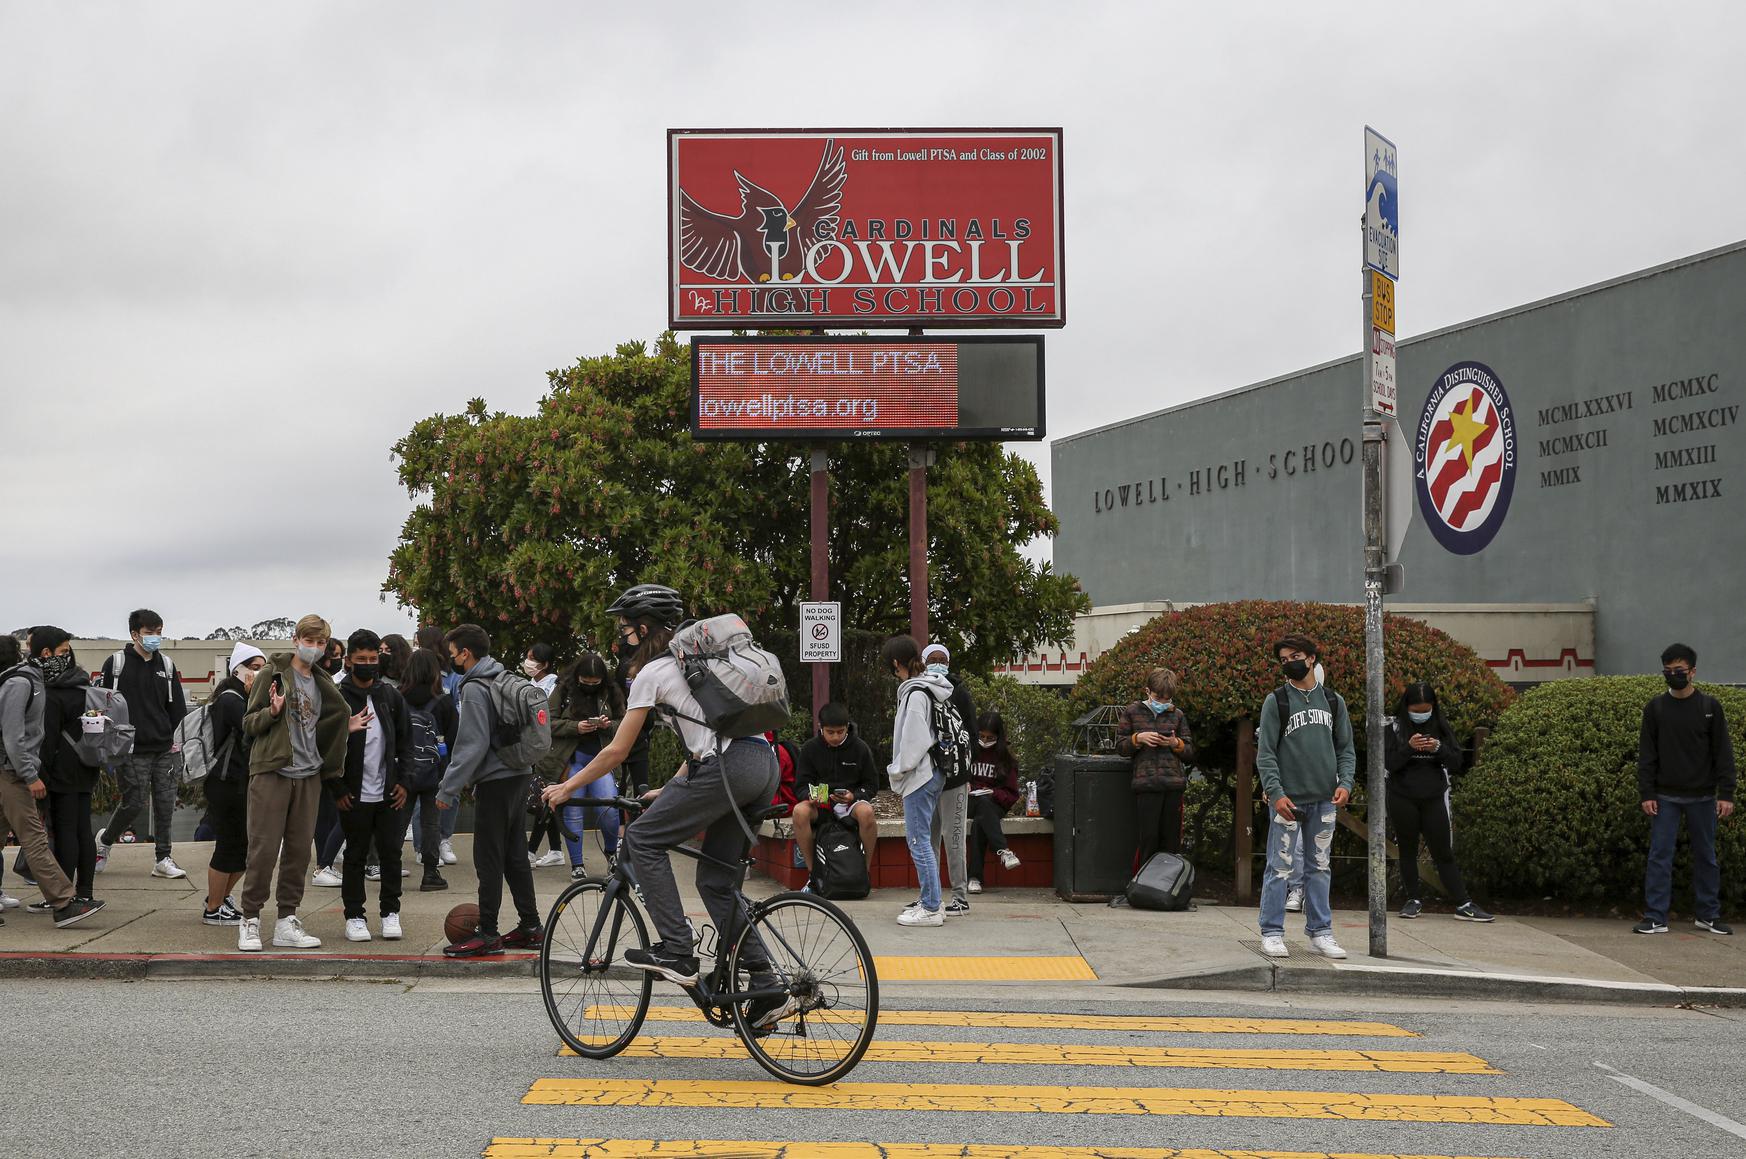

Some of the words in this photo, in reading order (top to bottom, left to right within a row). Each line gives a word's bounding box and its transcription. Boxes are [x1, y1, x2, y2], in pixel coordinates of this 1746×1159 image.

[851, 148, 868, 161] Gift
[872, 149, 894, 161] from
[897, 149, 927, 161] Lowell
[930, 149, 957, 160] PTSA
[959, 149, 977, 161] and
[979, 148, 1005, 160] Class
[1007, 148, 1018, 160] of
[1020, 148, 1046, 160] 2002
[813, 217, 1032, 241] CARDINALS
[764, 240, 1045, 285] LOWELL
[712, 288, 831, 314] HIGH
[853, 287, 1046, 314] SCHOOL
[1376, 277, 1391, 303] BUS
[1375, 301, 1393, 326] STOP
[699, 352, 745, 375] THE
[754, 352, 864, 375] LOWELL
[872, 351, 943, 374] PTSA
[1444, 367, 1504, 406] DISTINGUISHED
[1652, 373, 1720, 404] MCMXC
[1538, 391, 1633, 427] MCMLXXXVI
[1653, 405, 1740, 437] MCMXCIV
[1416, 387, 1444, 463] CALIFORNIA
[1500, 407, 1514, 470] SCHOOL
[1539, 429, 1608, 457] MCMXCII
[1654, 445, 1717, 470] MMXIII
[1094, 477, 1170, 514] LOWELL
[1189, 459, 1247, 496] HIGH
[1268, 438, 1354, 479] SCHOO
[1416, 468, 1425, 479] A
[1540, 466, 1581, 488] MMIX
[1656, 478, 1723, 505] MMXIX
[1285, 711, 1307, 736] ACIFIC
[970, 762, 996, 777] OWE
